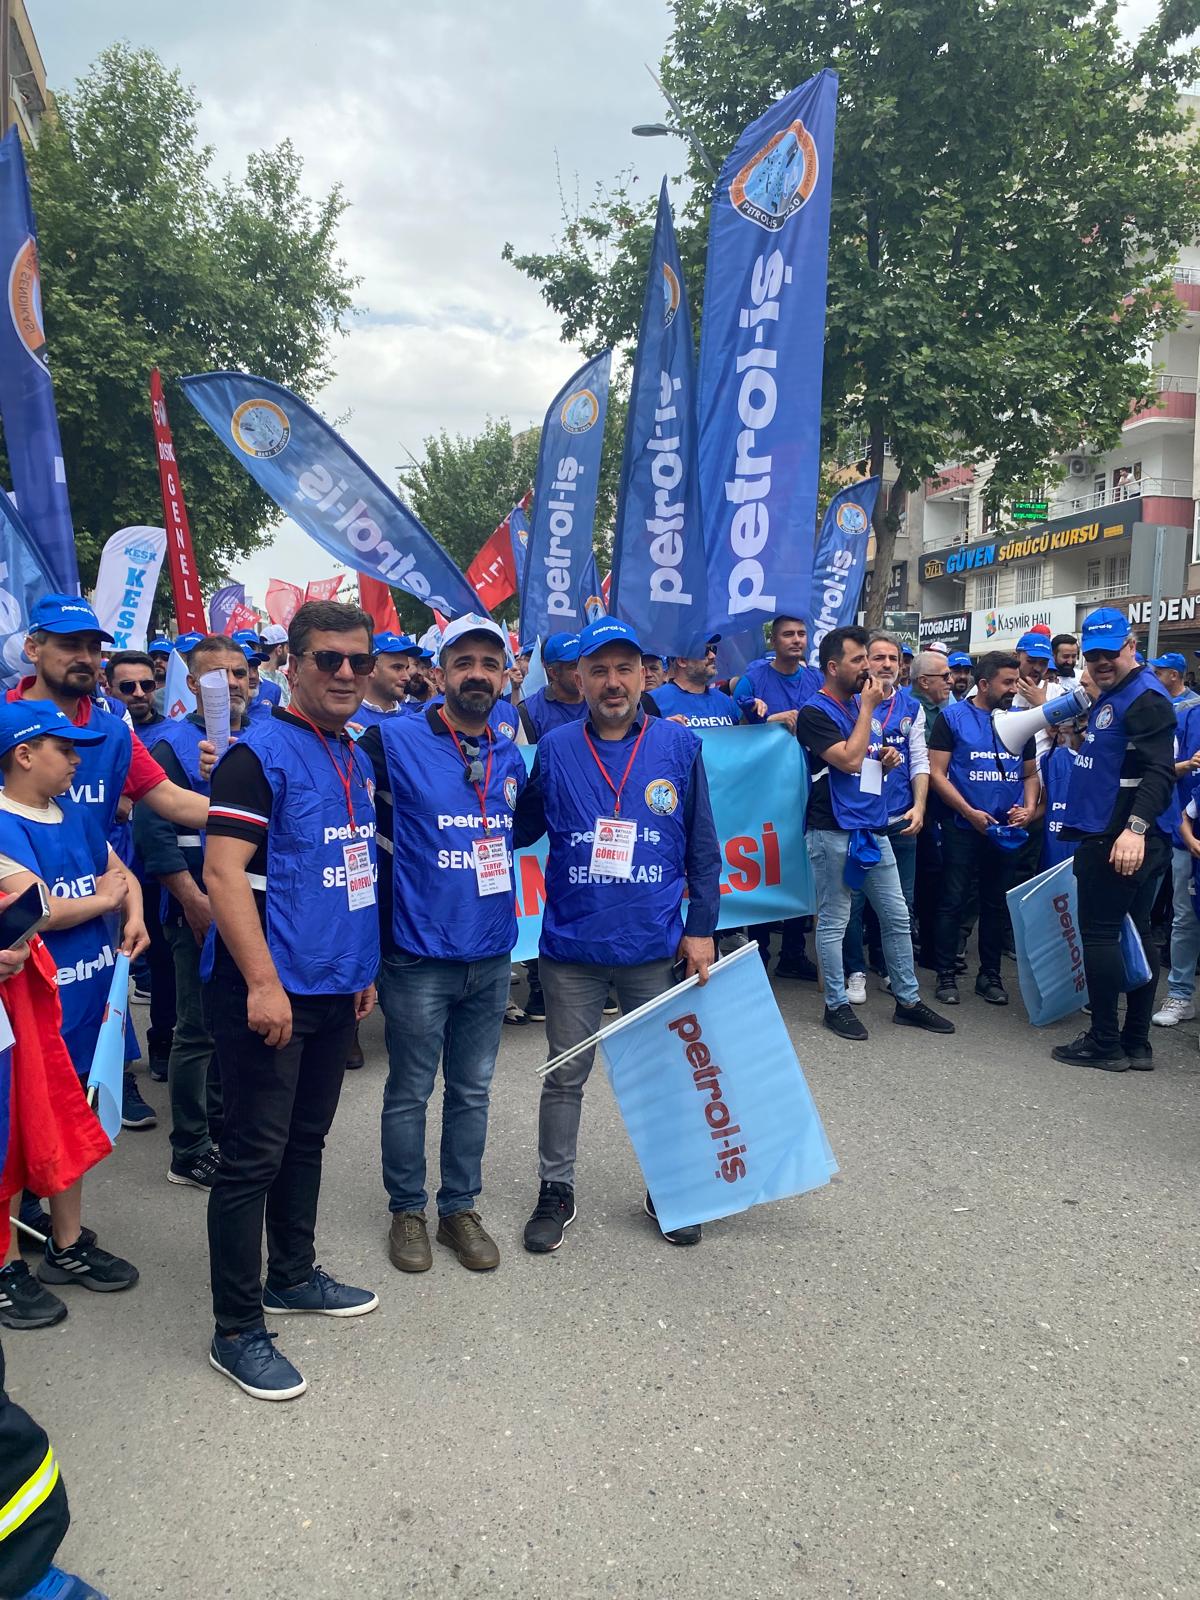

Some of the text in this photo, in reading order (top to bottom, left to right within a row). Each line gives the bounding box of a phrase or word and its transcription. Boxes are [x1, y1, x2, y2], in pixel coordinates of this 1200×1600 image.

[725, 249, 793, 615] petrol-iş
[544, 456, 584, 617] petrol-iş
[946, 543, 996, 574] GÜVEN
[998, 531, 1050, 561] SÜRÜCÜ
[1050, 522, 1099, 550] KURSU
[111, 567, 146, 649] KESK
[998, 612, 1030, 631] KAŞMİR
[666, 1013, 748, 1184] petrol-iş
